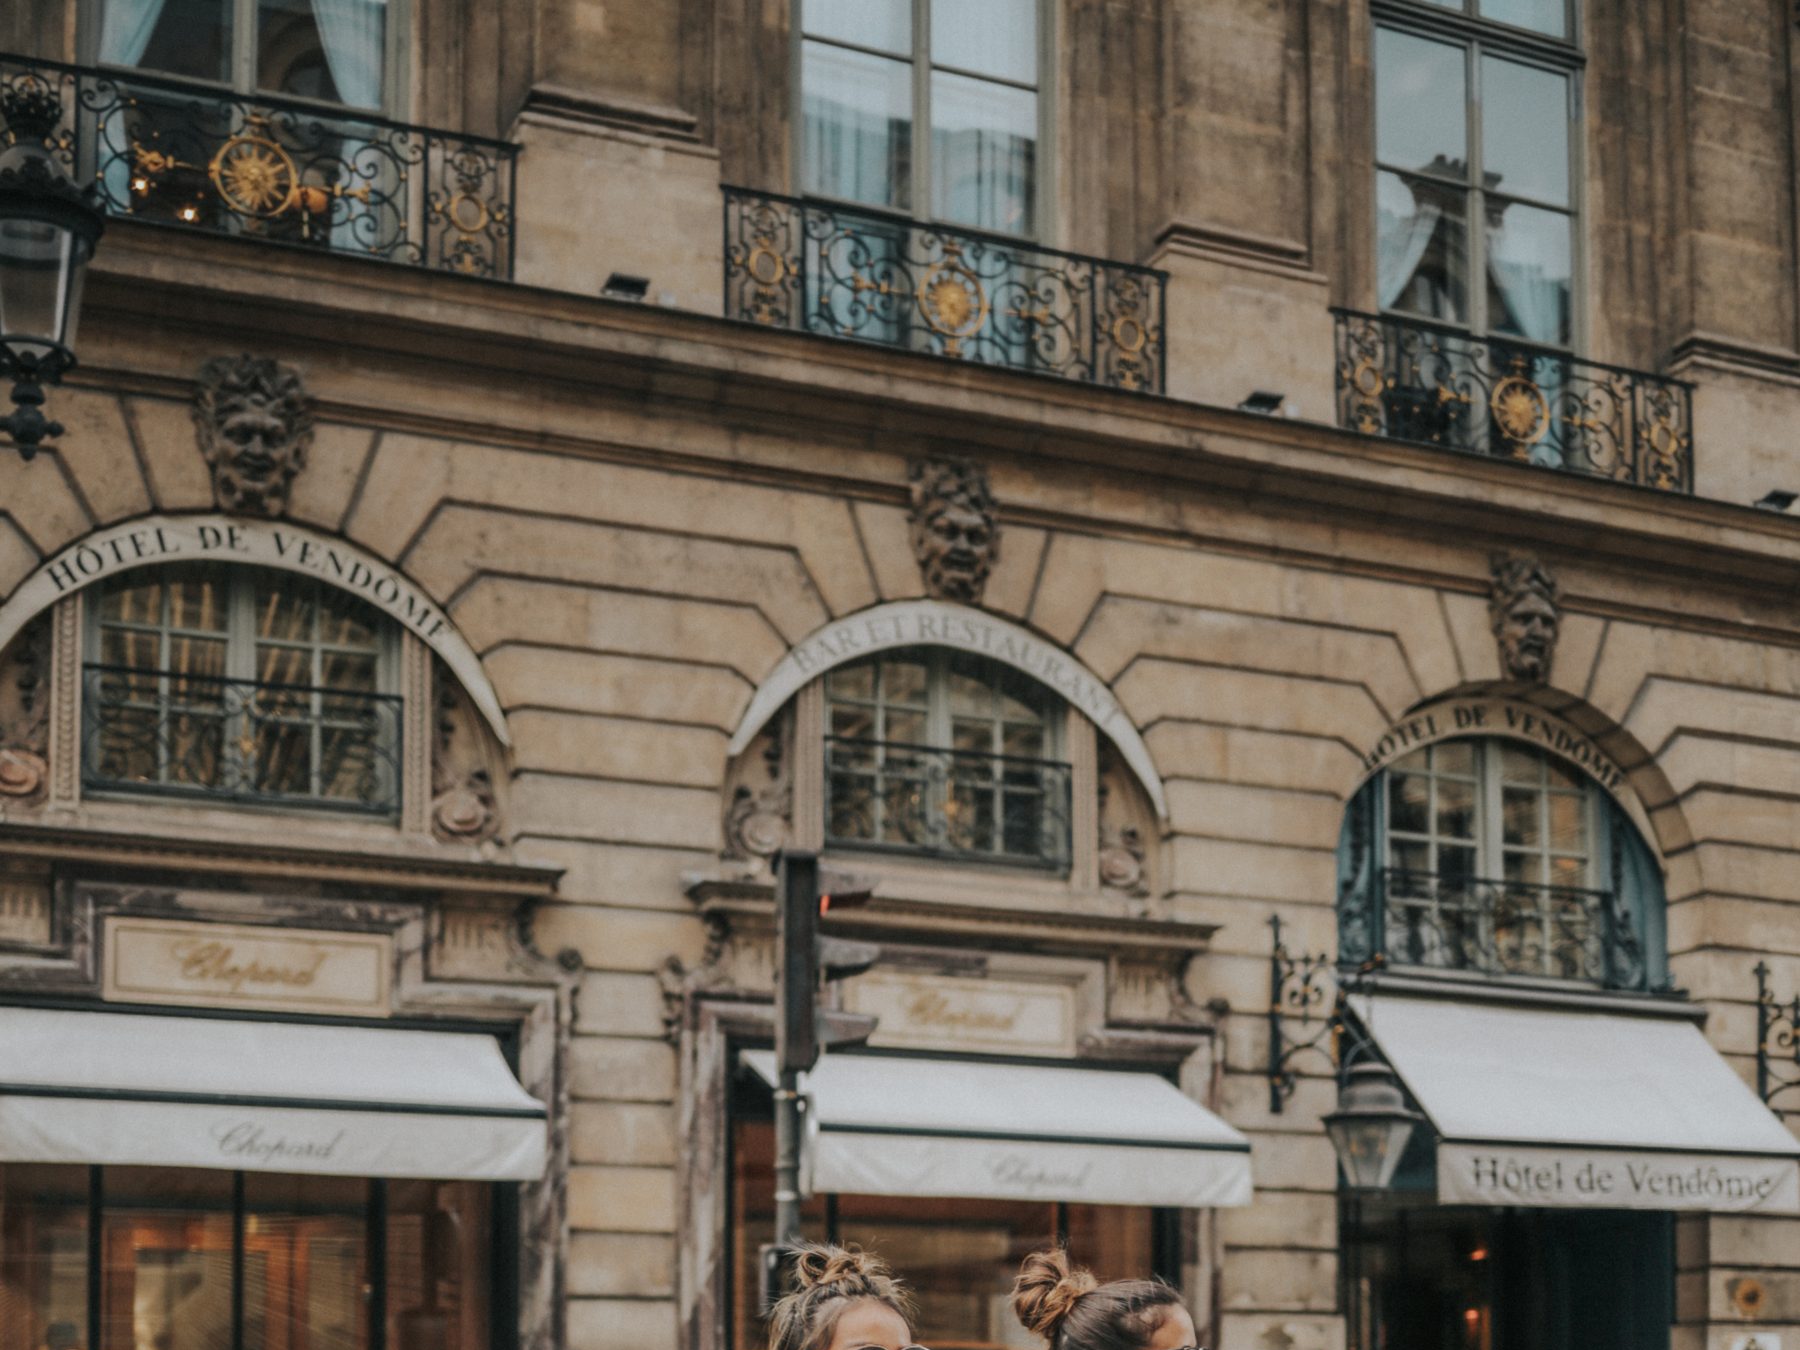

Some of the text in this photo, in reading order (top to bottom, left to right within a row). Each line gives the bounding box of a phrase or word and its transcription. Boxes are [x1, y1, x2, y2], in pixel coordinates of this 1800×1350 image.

[47, 526, 180, 592] HÔTEL
[197, 525, 249, 554] DE
[792, 613, 1119, 724] BAR ET RESTAURANT
[1453, 705, 1488, 729] DE
[209, 1120, 346, 1164] Chopard
[1472, 1156, 1771, 1200] Hôtel de Vendôme
